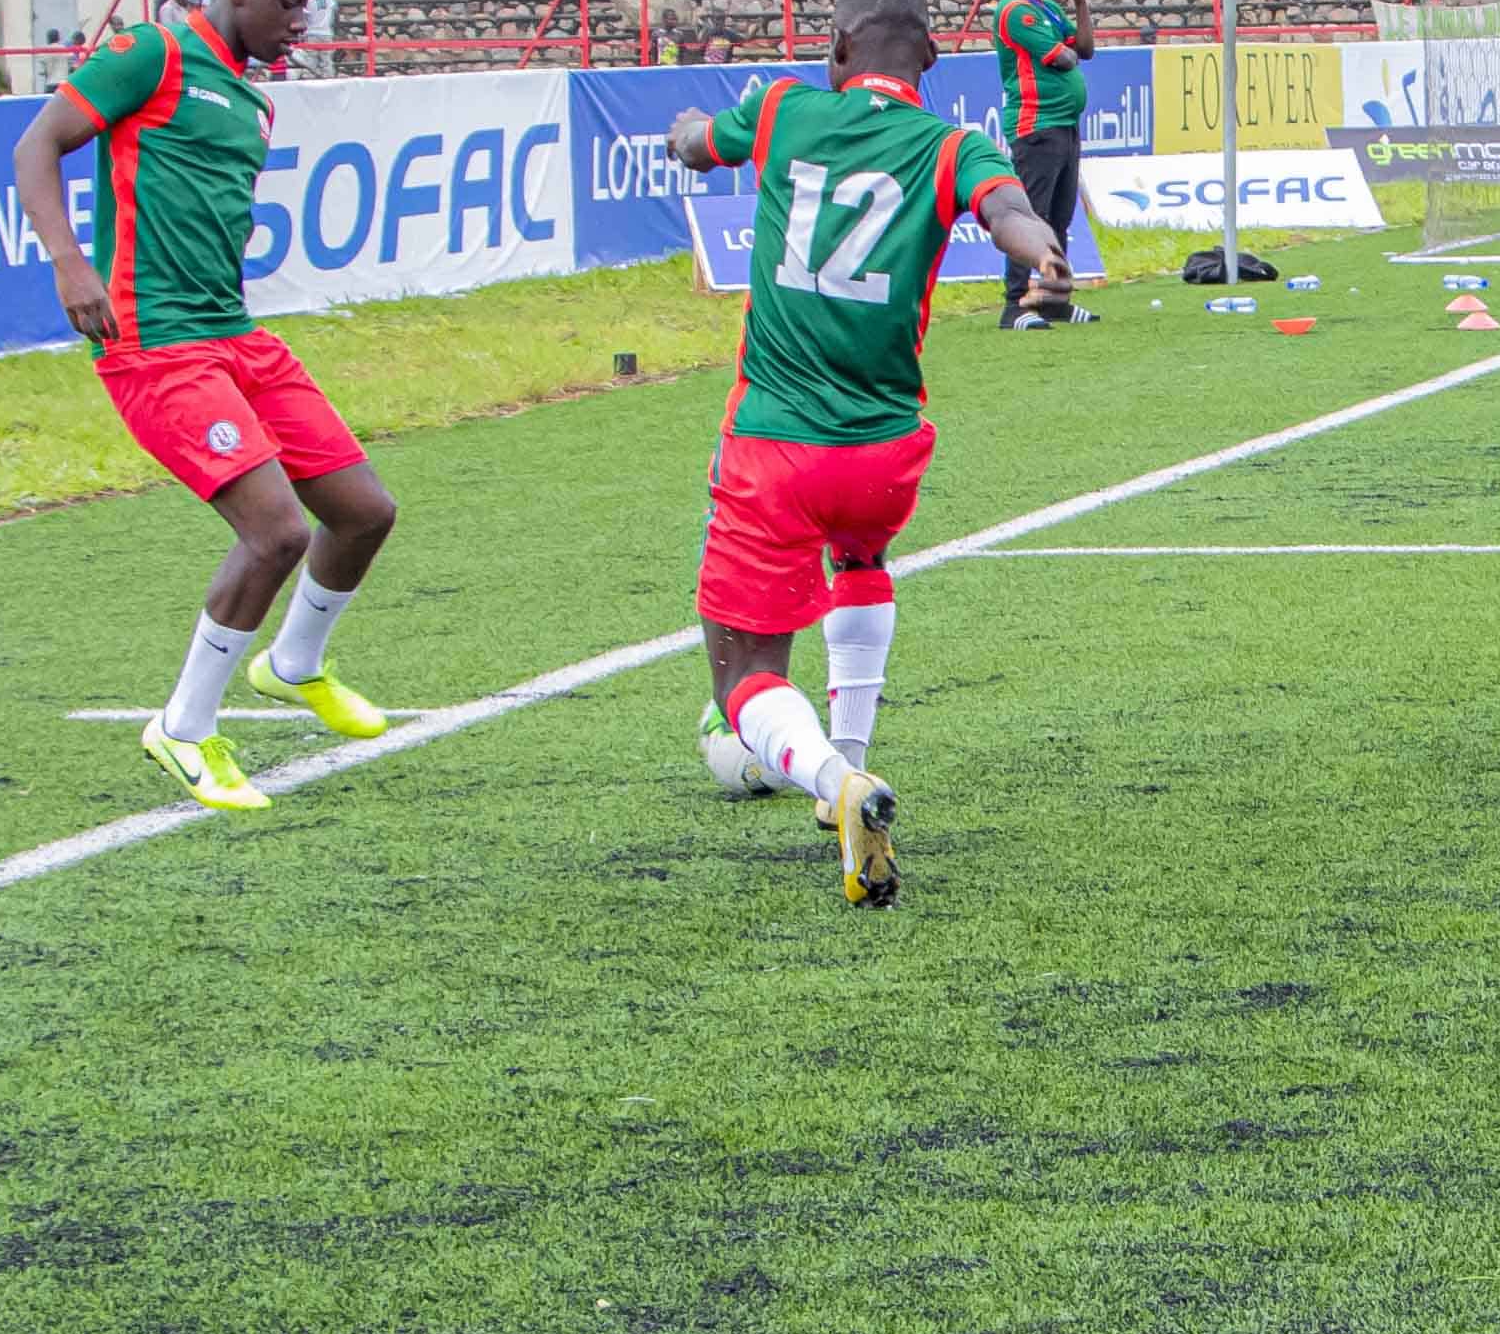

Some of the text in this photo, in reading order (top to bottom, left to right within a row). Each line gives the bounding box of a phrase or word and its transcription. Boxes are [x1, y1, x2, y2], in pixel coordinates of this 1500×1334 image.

[243, 122, 560, 280] SOFAC
[775, 160, 904, 304] 12
[1155, 176, 1347, 208] SOFAC
